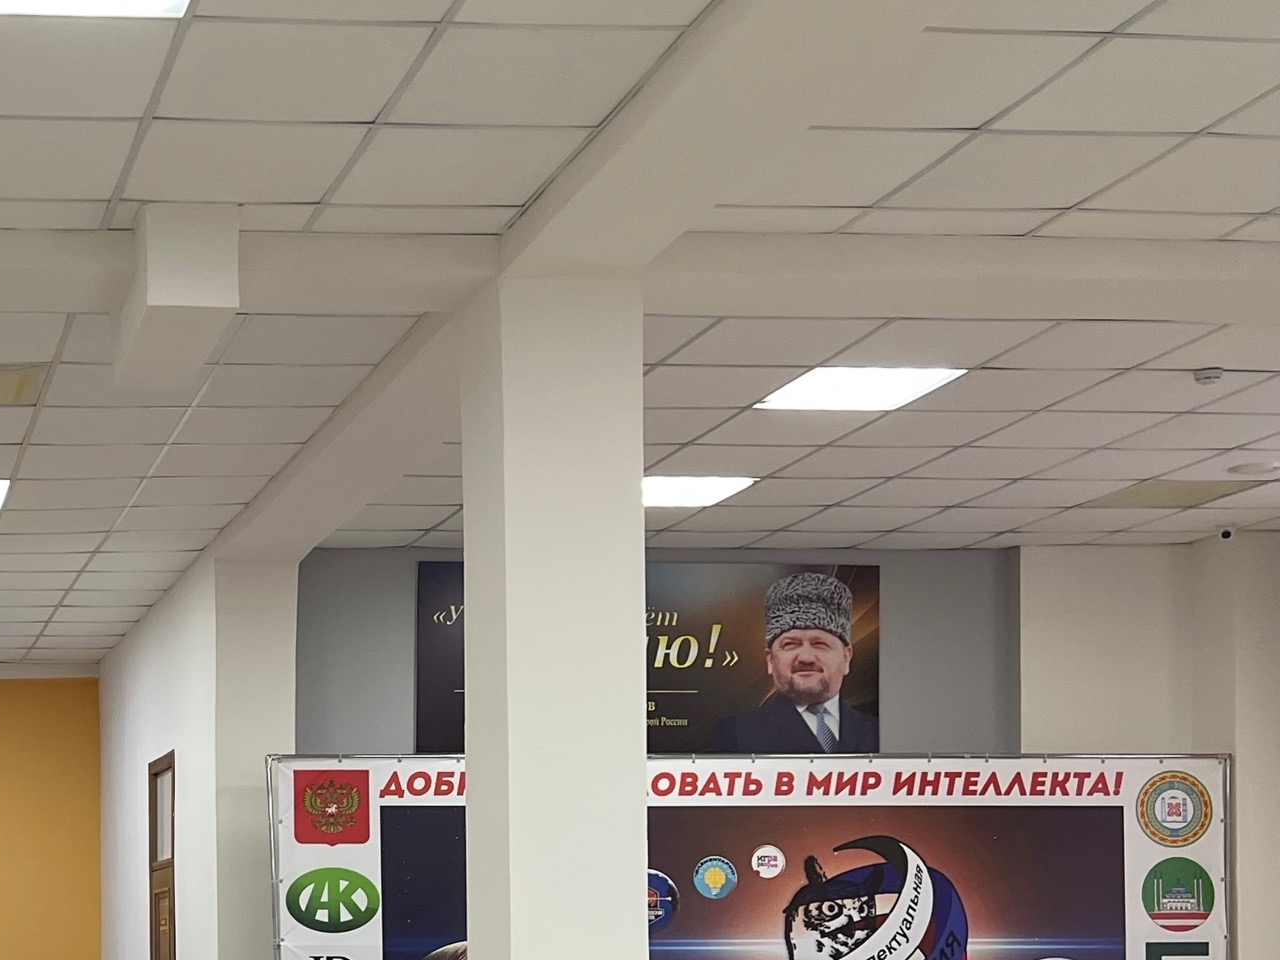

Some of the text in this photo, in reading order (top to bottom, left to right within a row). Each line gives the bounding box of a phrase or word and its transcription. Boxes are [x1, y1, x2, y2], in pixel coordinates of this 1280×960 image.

[646, 623, 739, 669] ю!»
[646, 771, 763, 797] ОВАТЬ
[774, 771, 794, 796] В
[806, 771, 882, 796] МИР
[892, 771, 1123, 796] ИНТЕЛЛЕКТА!
